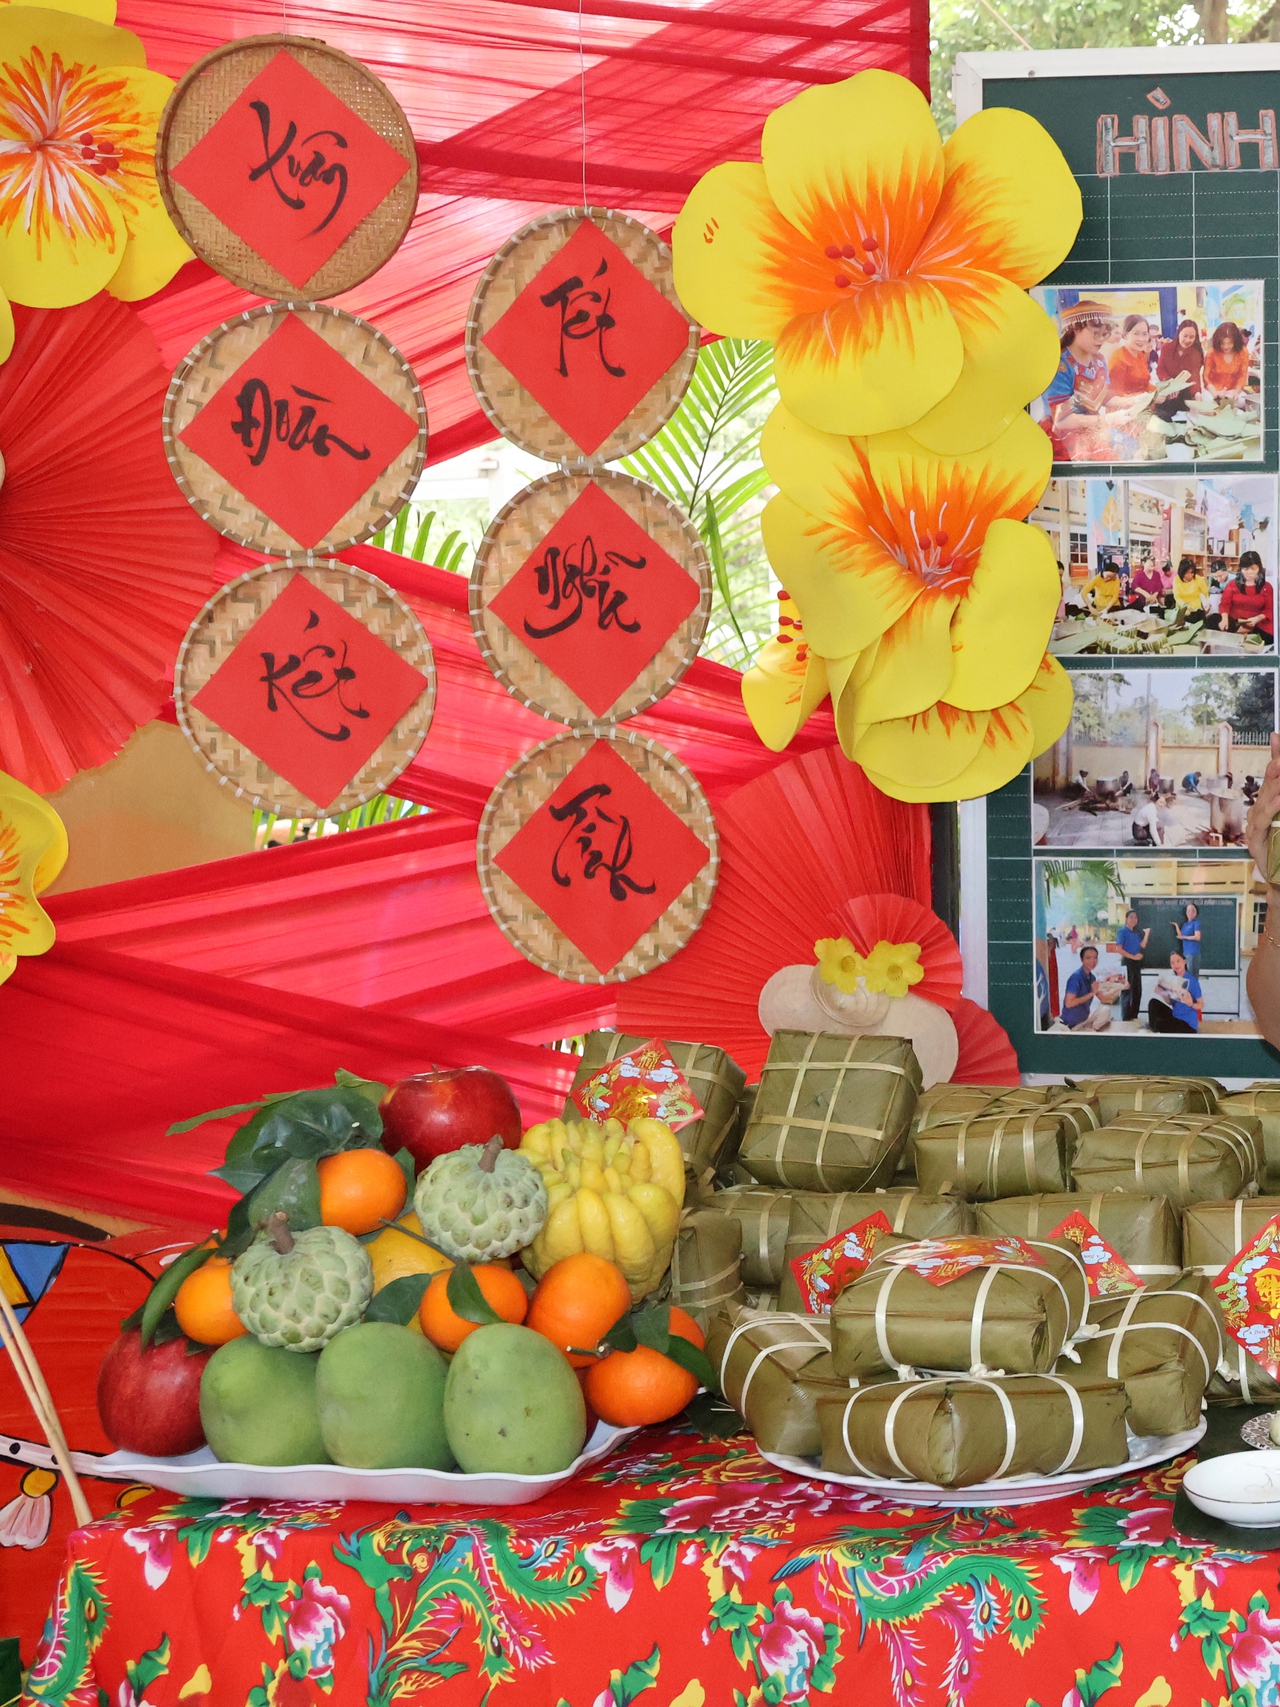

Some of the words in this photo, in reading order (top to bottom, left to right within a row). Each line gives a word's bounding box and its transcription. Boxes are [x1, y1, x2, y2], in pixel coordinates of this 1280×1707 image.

[248, 99, 350, 241] Xuân
[1096, 87, 1279, 177] HÌNH
[540, 256, 627, 379] Tết
[230, 376, 371, 467] Đoàn
[259, 608, 370, 742] Kết
[548, 782, 657, 902] Tình
